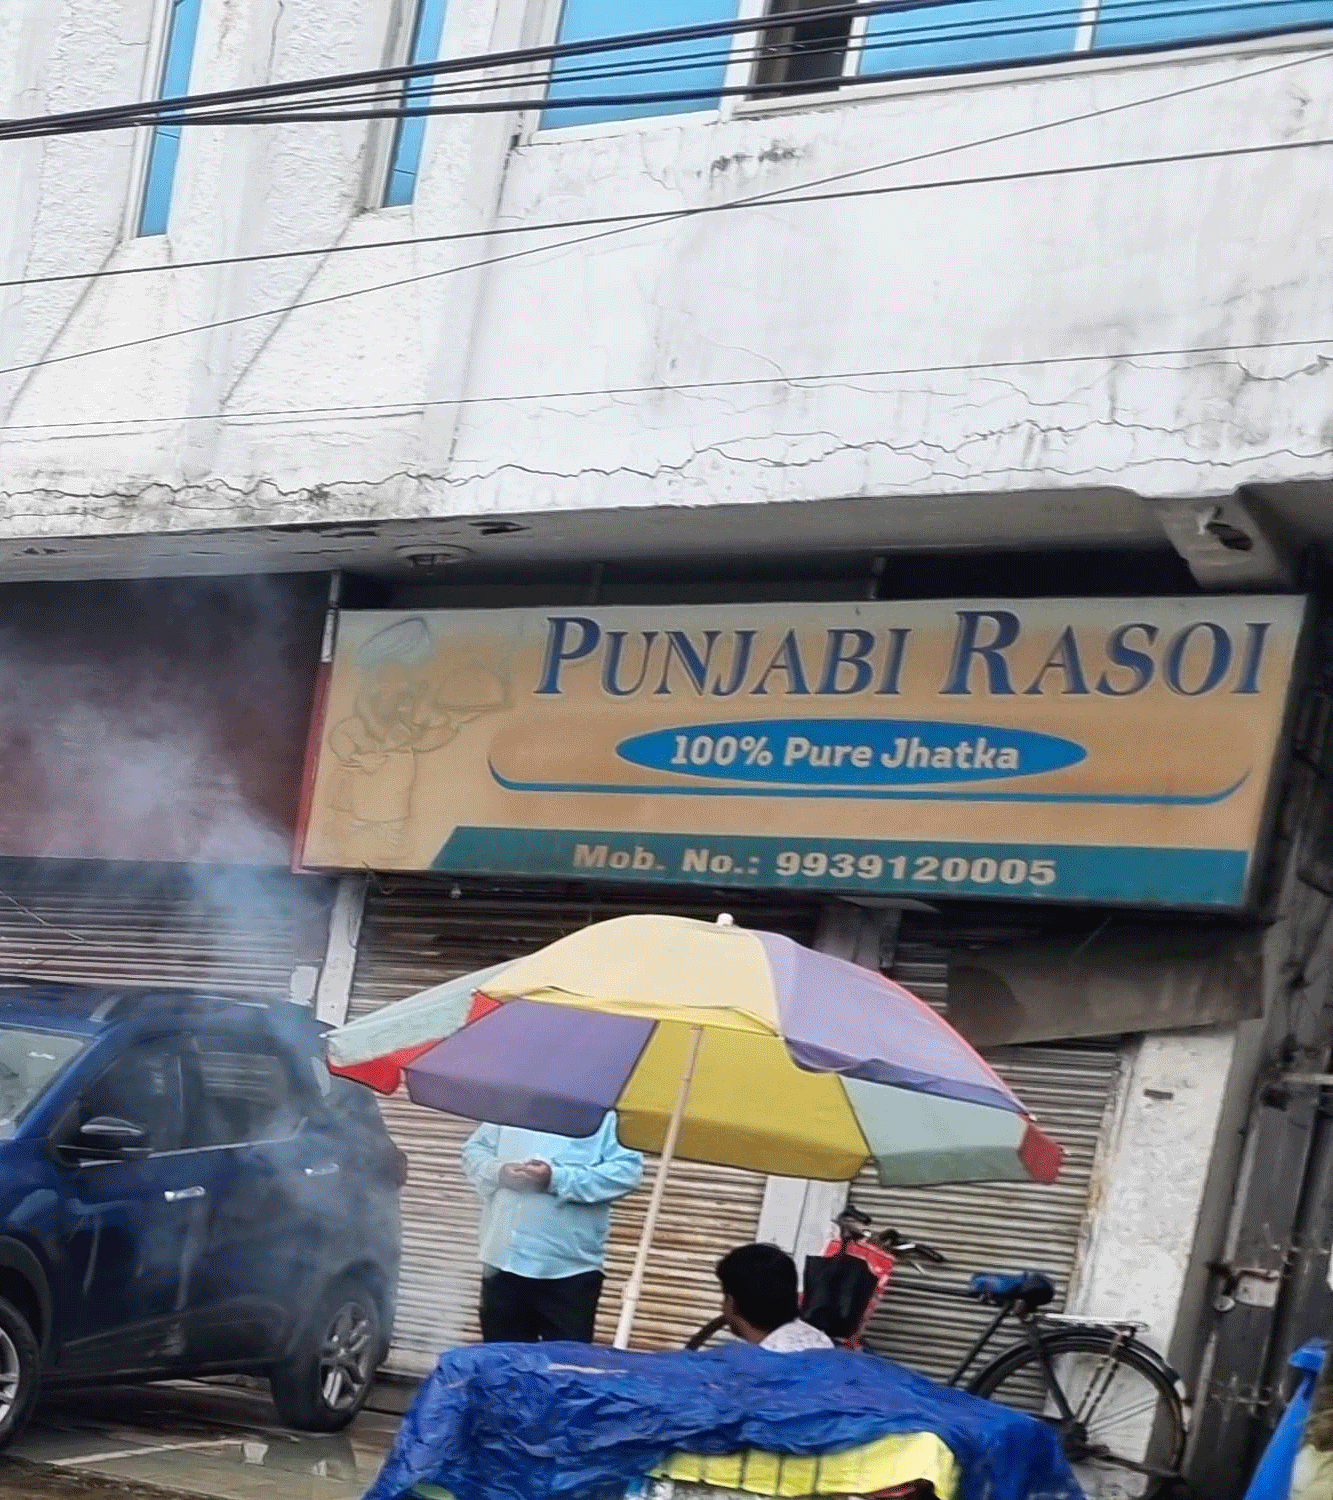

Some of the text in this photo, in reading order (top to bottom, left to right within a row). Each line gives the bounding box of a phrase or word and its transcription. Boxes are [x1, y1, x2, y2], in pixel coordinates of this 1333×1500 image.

[532, 609, 1273, 697] PUNJABI RASOI
[670, 733, 1020, 769] 100% Pure Jhatka
[573, 843, 666, 872] Mob.
[775, 851, 1058, 887] 9939120005
